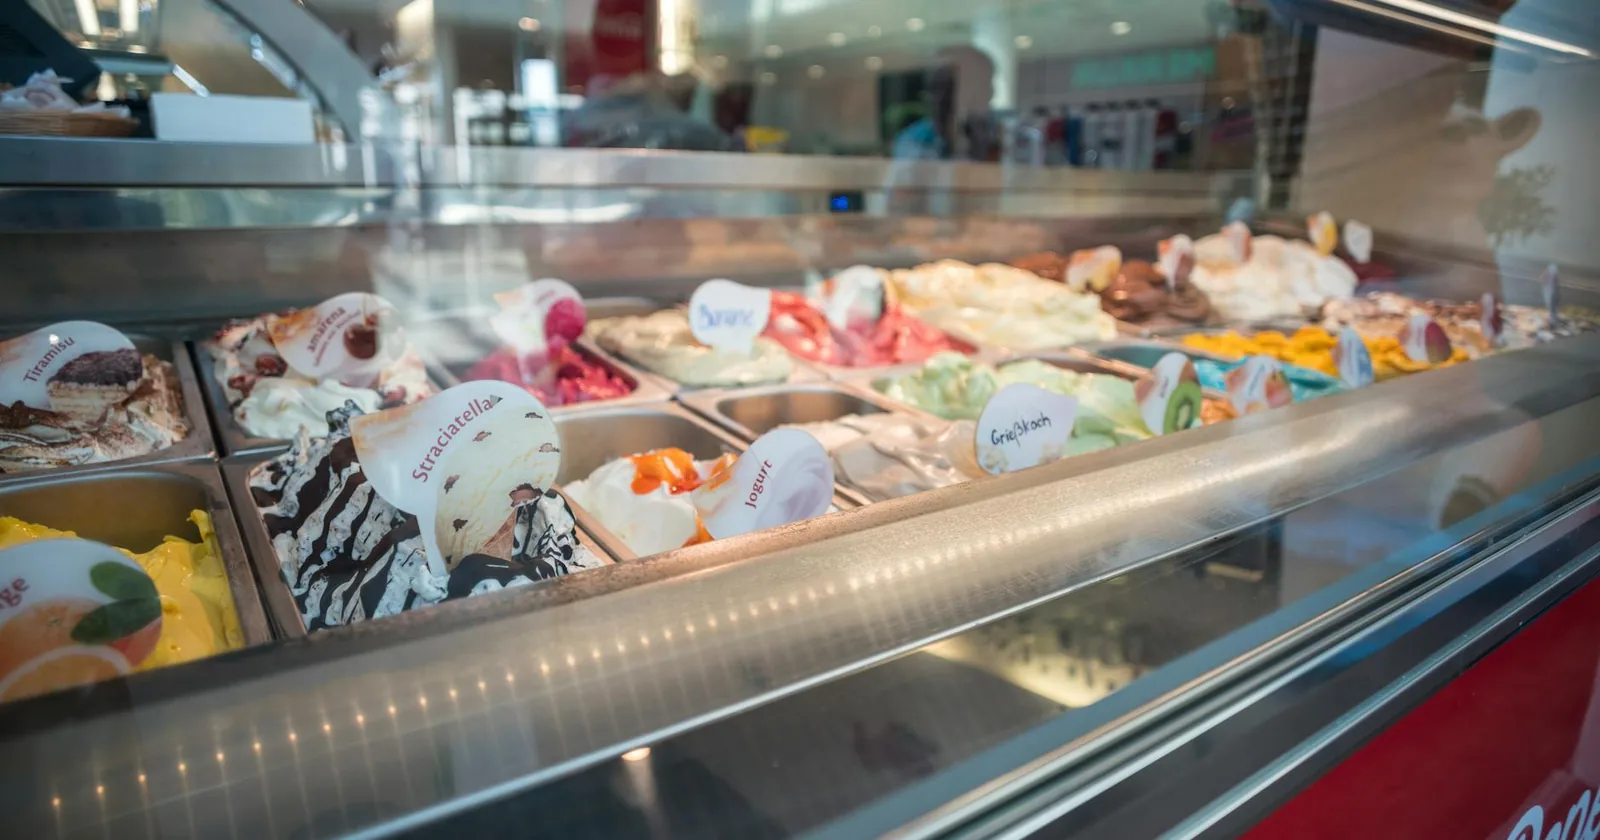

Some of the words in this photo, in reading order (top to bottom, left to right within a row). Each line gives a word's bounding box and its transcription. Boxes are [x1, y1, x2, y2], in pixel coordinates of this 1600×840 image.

[307, 307, 346, 352] amarena
[23, 336, 75, 381] Tiramisu
[412, 399, 493, 483] Straciatella
[991, 411, 1051, 448] Grießkoch
[745, 459, 773, 510] Jogurt
